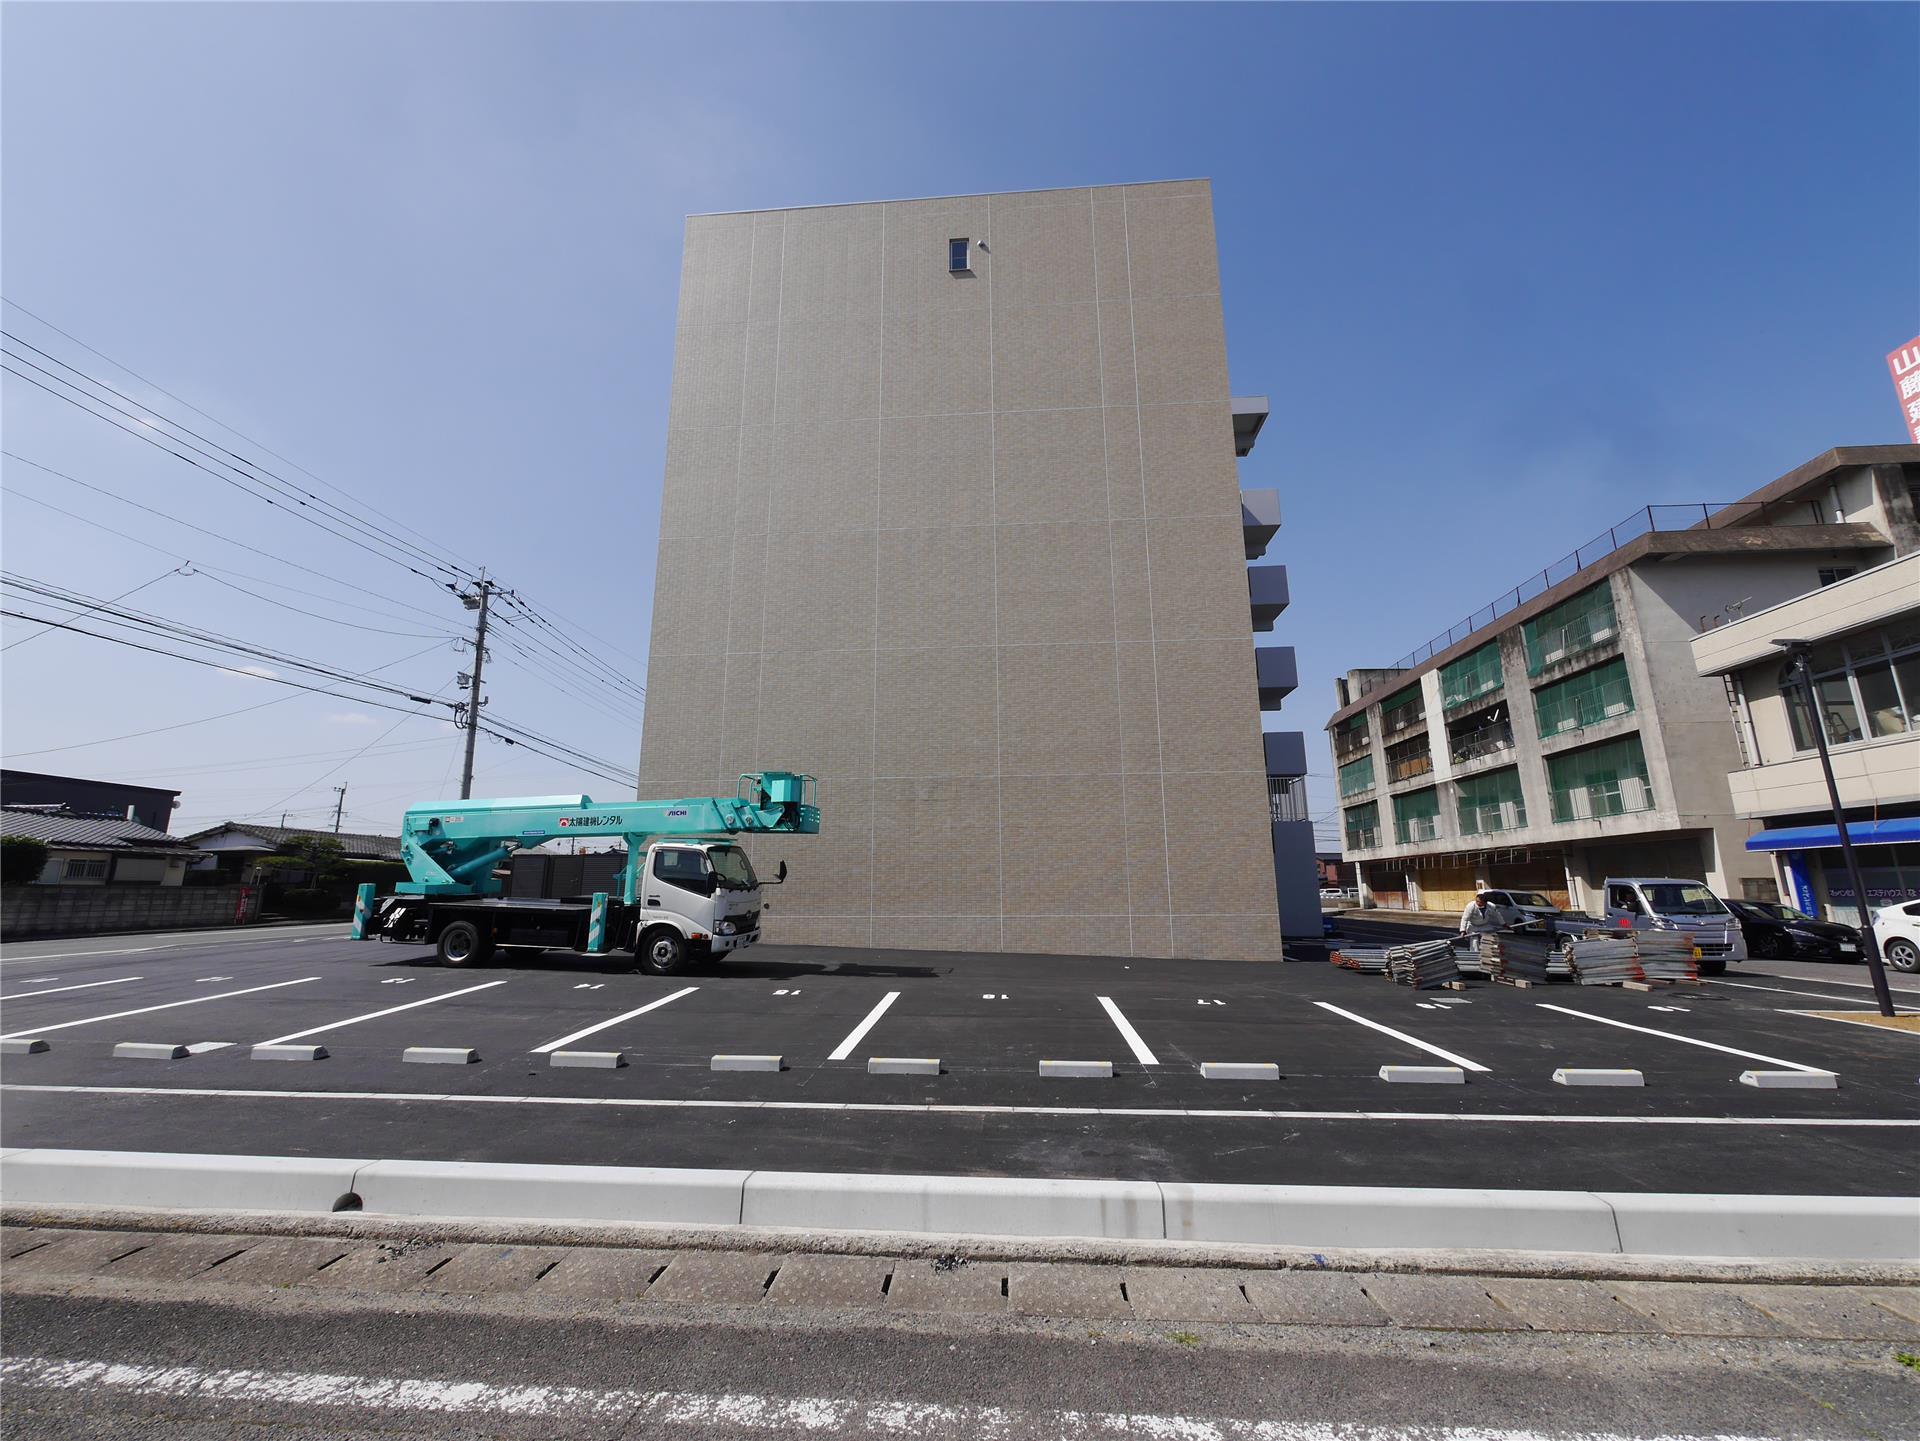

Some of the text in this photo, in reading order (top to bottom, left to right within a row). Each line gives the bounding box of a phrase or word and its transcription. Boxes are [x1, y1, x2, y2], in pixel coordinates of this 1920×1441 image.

[569, 815, 623, 827] 太陽建機レンタル
